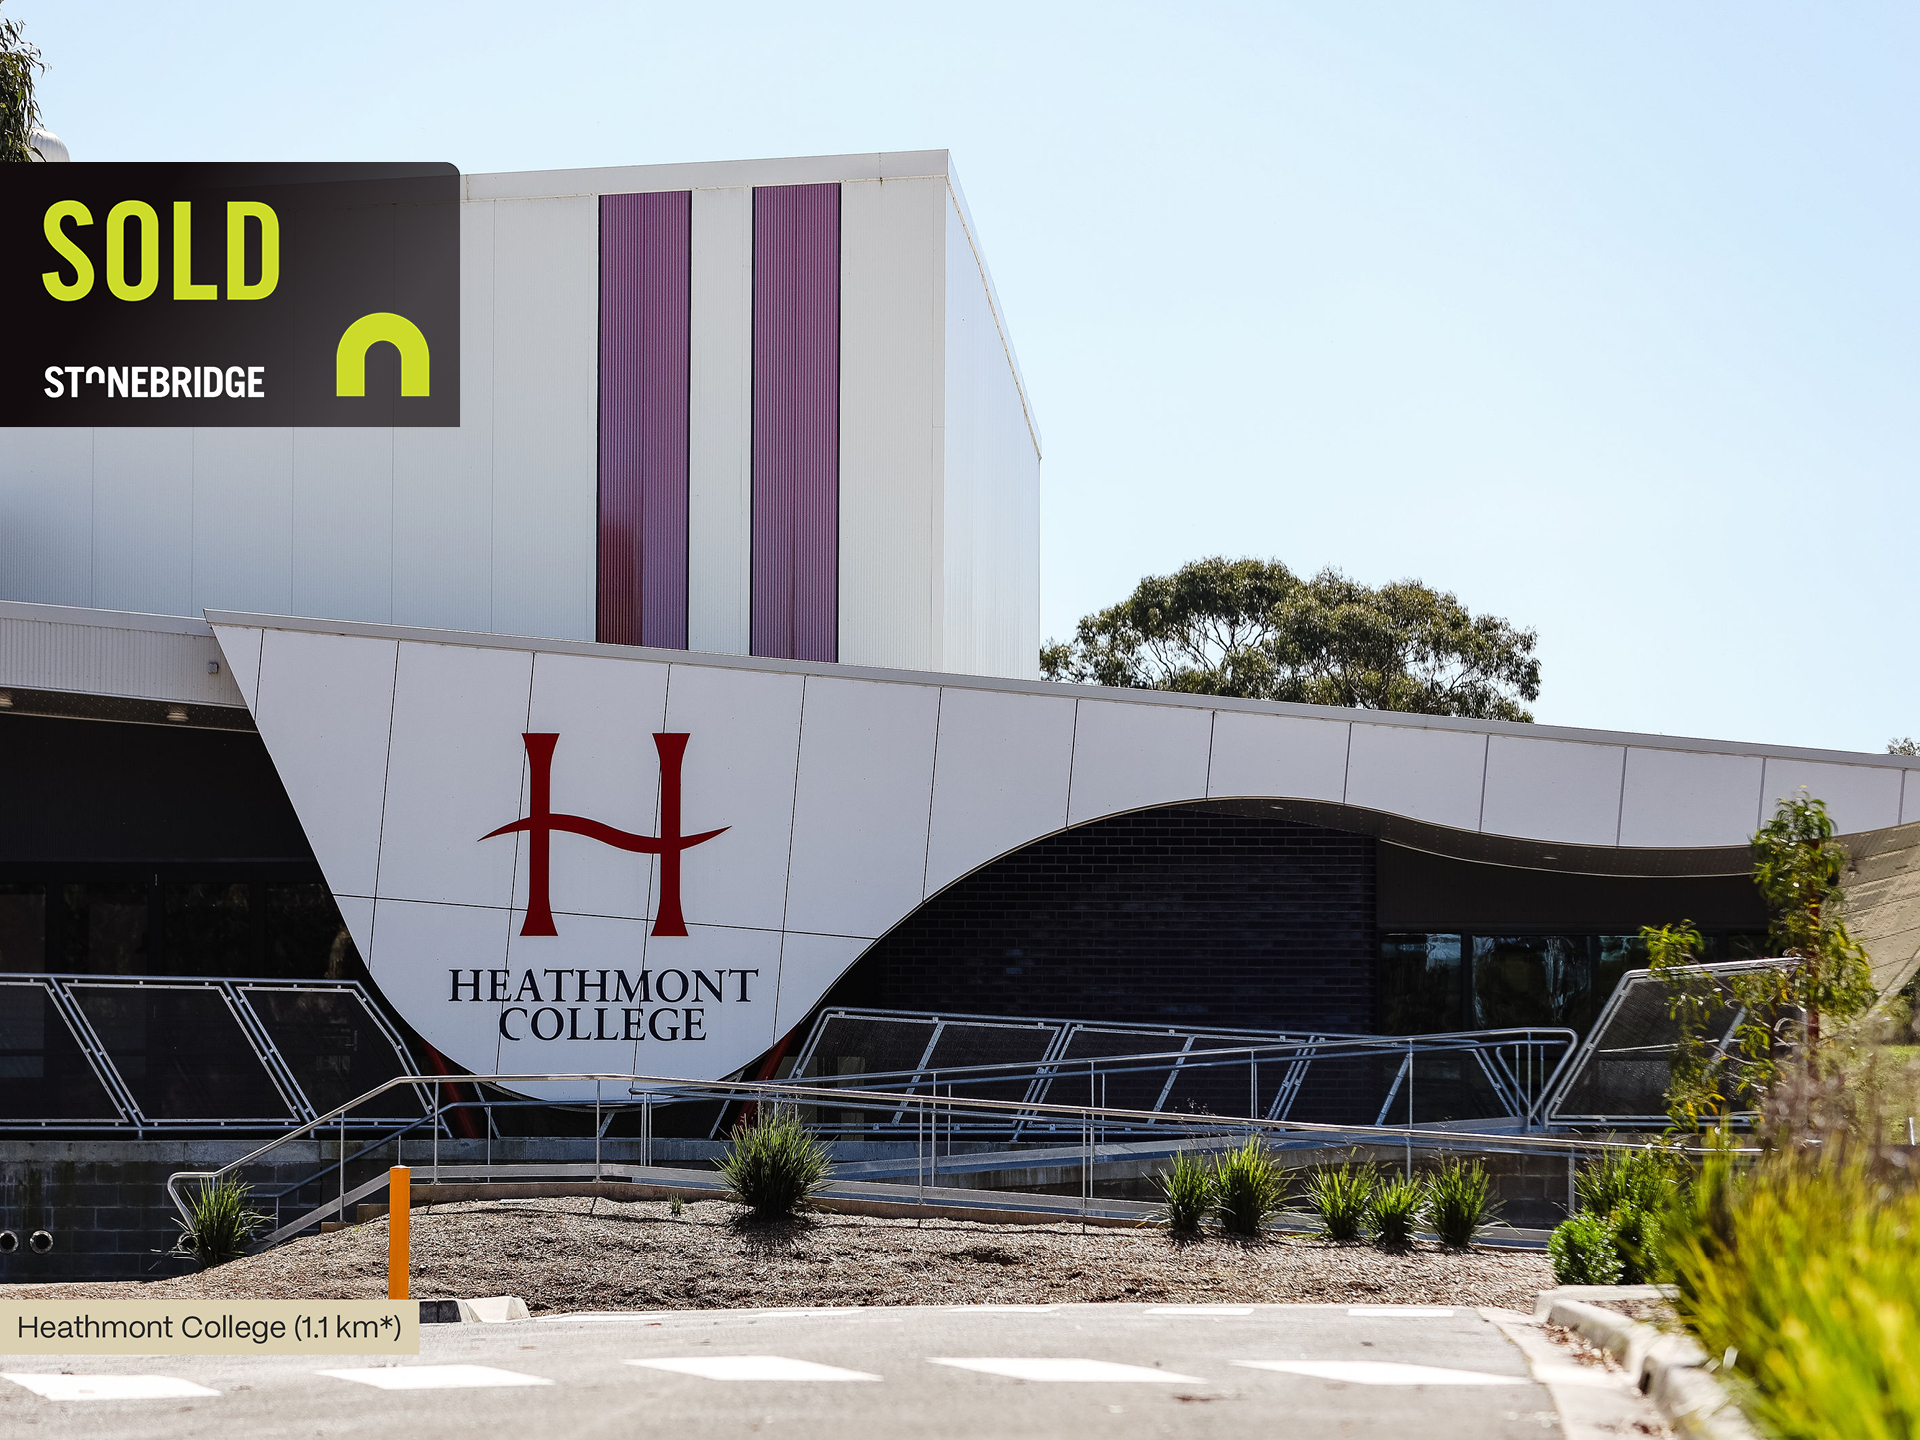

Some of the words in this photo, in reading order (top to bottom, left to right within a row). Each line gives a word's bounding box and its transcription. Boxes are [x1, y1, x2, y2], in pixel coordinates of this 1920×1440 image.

[477, 733, 733, 936] H
[448, 968, 759, 1003] HEATHMONT
[499, 1006, 707, 1041] COLLEGE
